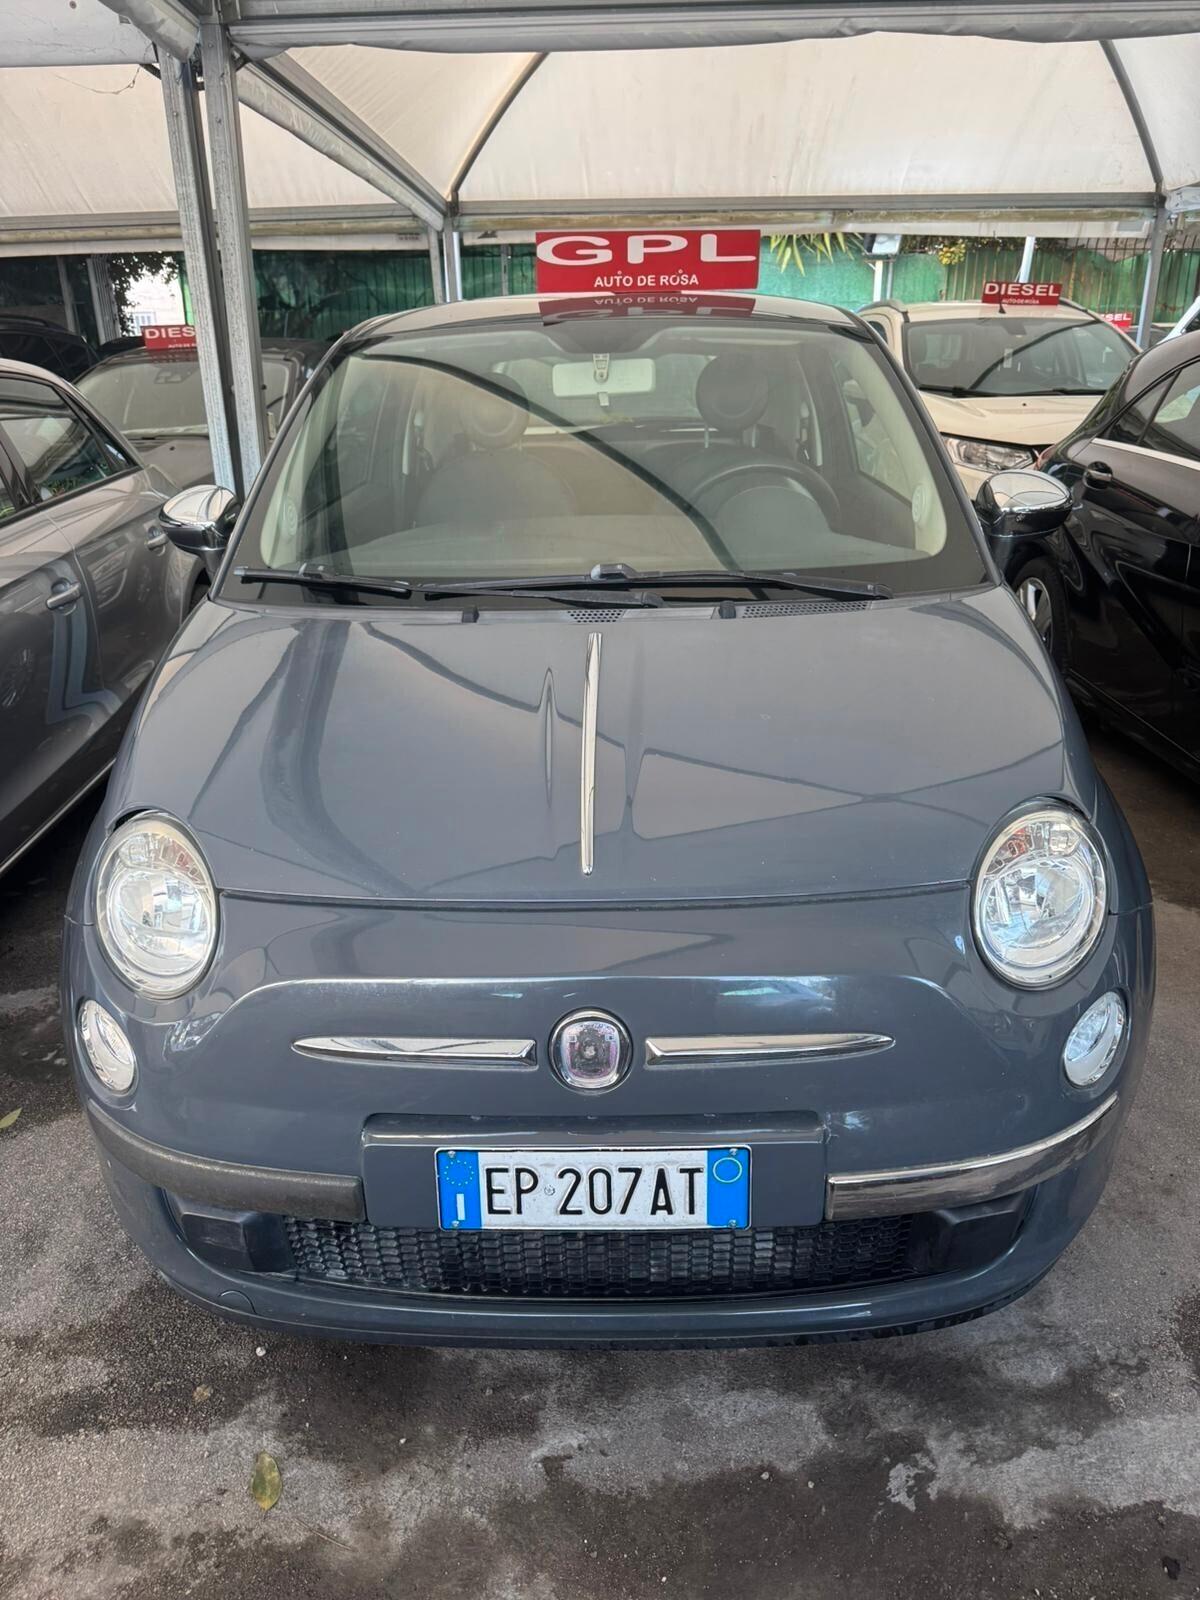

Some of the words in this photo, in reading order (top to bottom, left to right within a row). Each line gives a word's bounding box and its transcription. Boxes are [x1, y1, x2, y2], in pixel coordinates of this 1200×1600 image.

[536, 233, 757, 266] GPL
[593, 275, 634, 288] AUTO
[637, 275, 656, 287] DE
[660, 273, 699, 286] ROSA
[984, 282, 1060, 297] DIESEL
[485, 1167, 539, 1215] EP
[557, 1166, 704, 1216] 207AT
